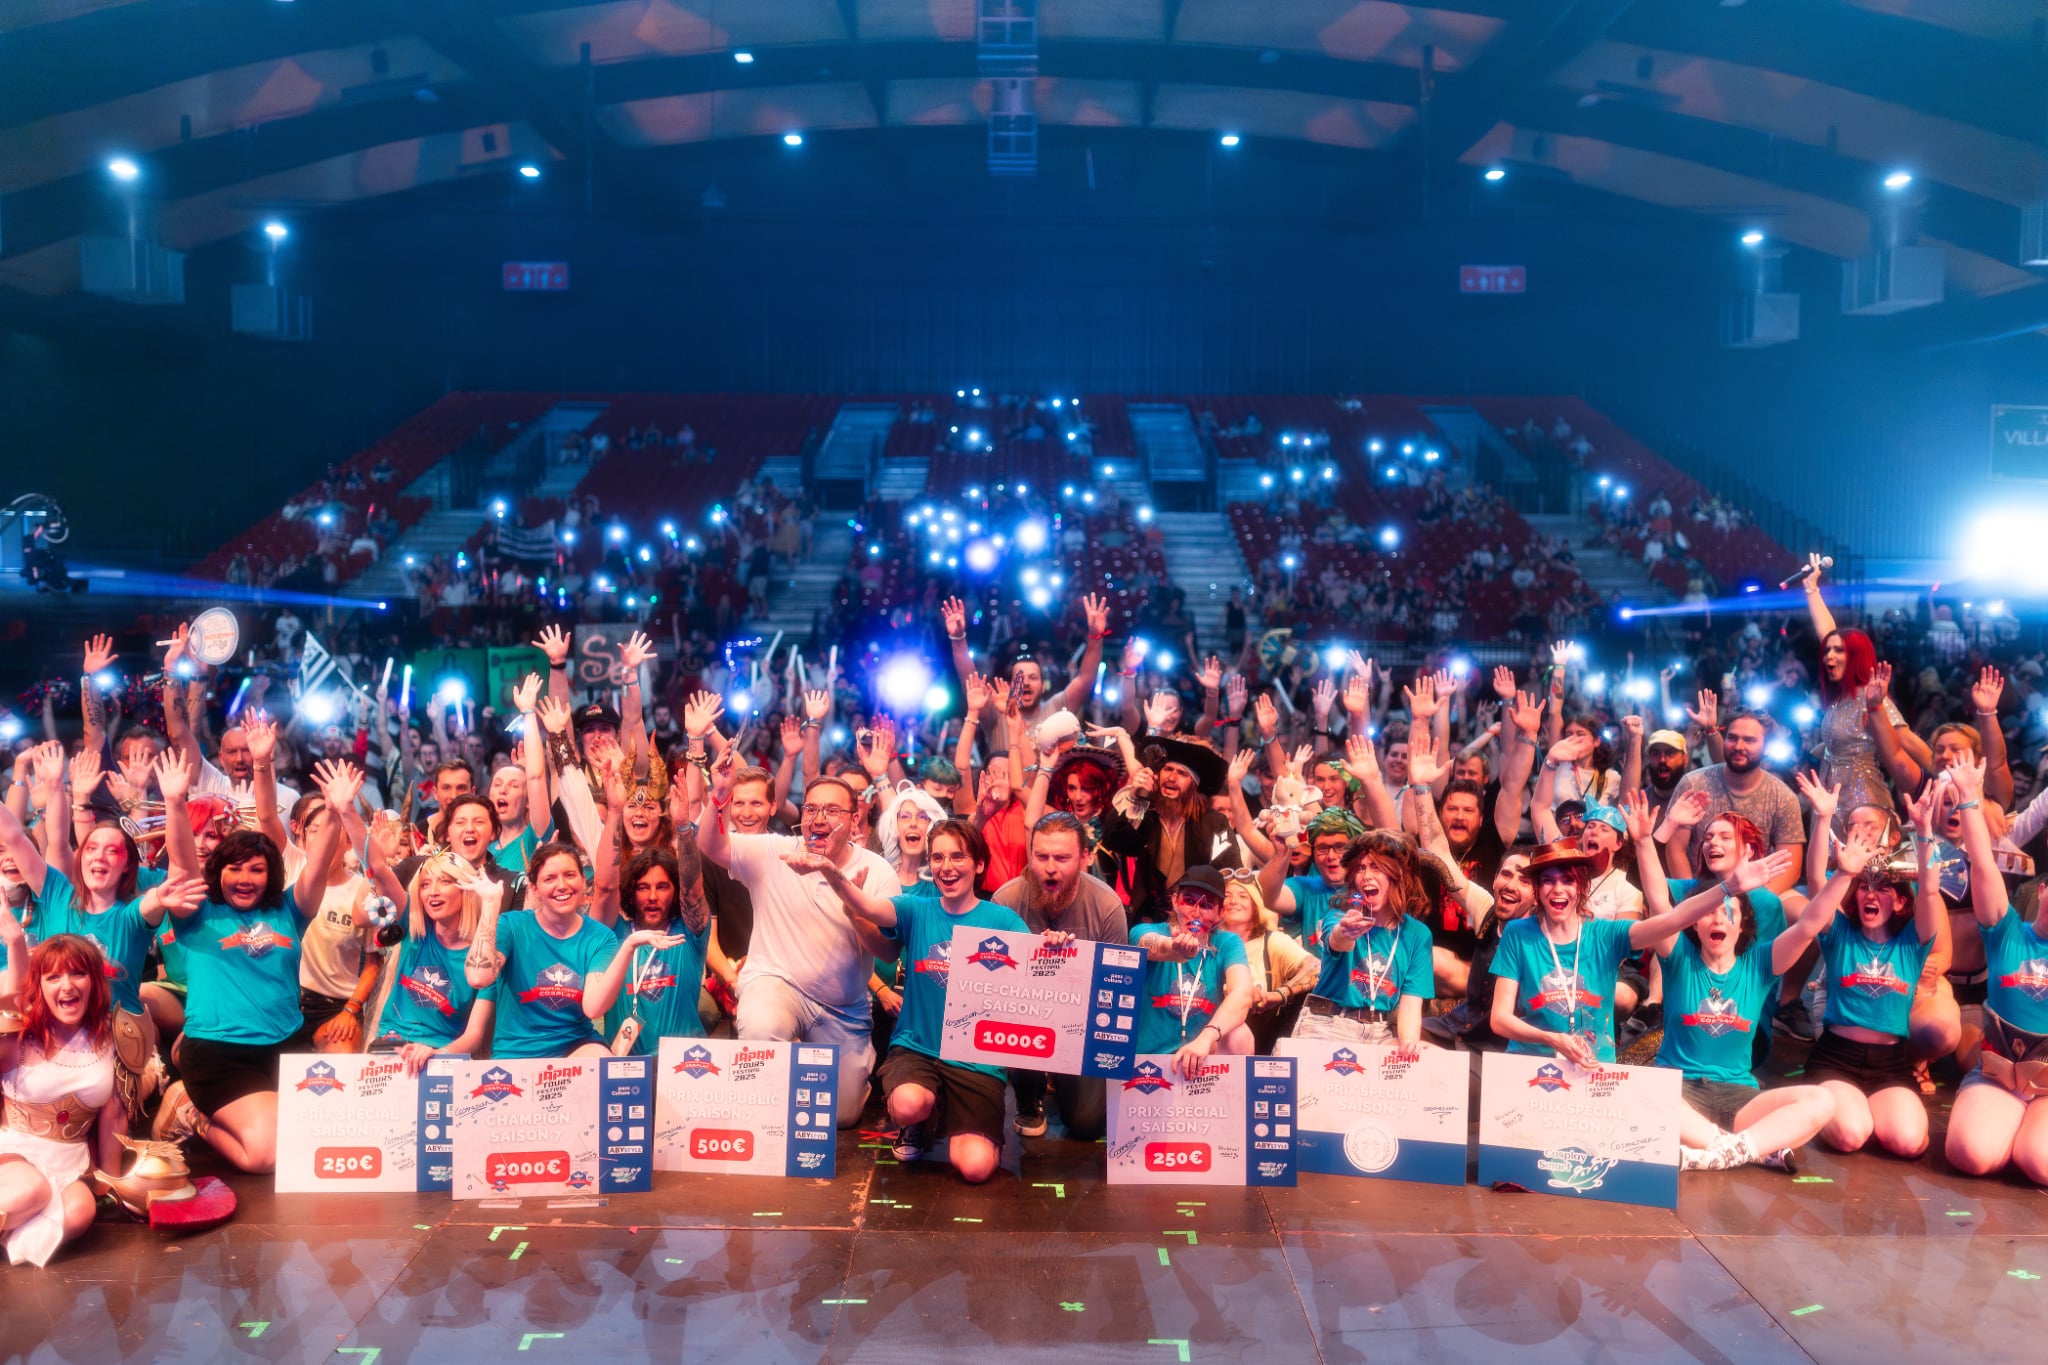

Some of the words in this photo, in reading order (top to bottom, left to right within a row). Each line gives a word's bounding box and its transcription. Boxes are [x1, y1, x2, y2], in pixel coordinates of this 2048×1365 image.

[326, 910, 353, 927] G.G
[1030, 943, 1078, 961] JAPAN
[409, 984, 442, 1003] COSPLAY
[958, 980, 1082, 1005] VICE-CHAMPION
[982, 999, 1041, 1016] SAISON
[1044, 1007, 1054, 1020] 7
[982, 1031, 1047, 1050] 1000€
[731, 1046, 775, 1066] JAPAN
[357, 1061, 403, 1081] JAPAN
[738, 1061, 765, 1069] TOURS
[1201, 1064, 1230, 1076] PAN
[365, 1075, 392, 1084] TOURS
[535, 1065, 582, 1086] JAPAN
[1588, 1068, 1629, 1084] JAPAN
[543, 1079, 572, 1088] TOURS
[1326, 1083, 1357, 1095] PRIX
[361, 1088, 383, 1097] 2025
[538, 1092, 563, 1101] 2025
[668, 1090, 701, 1103] PRIX
[704, 1091, 724, 1103] DU
[729, 1092, 780, 1106] PUBLIC
[1188, 1088, 1211, 1096] 2025
[688, 1107, 741, 1119] SAISON
[745, 1111, 753, 1120] 7
[1127, 1106, 1161, 1118] PRIX
[1337, 1099, 1393, 1115] SAISON
[1397, 1105, 1407, 1119] 7
[1530, 1099, 1562, 1113] PRIX
[299, 1107, 333, 1121] PRIX
[485, 1112, 570, 1127] CHAMPION
[312, 1125, 368, 1137] SAISON
[372, 1127, 380, 1138] 7
[1141, 1121, 1197, 1133] SAISON
[1201, 1123, 1211, 1135] 7
[1543, 1116, 1601, 1132] SAISON
[1607, 1123, 1616, 1138] 7
[490, 1130, 549, 1143] SAISON
[553, 1131, 562, 1142] 7
[697, 1138, 746, 1154] 500€
[1153, 1150, 1203, 1167] 250€
[1544, 1150, 1587, 1162] Cosplay
[322, 1155, 373, 1173] 250€
[494, 1159, 561, 1176] 2000€
[1539, 1160, 1570, 1171] Smart
